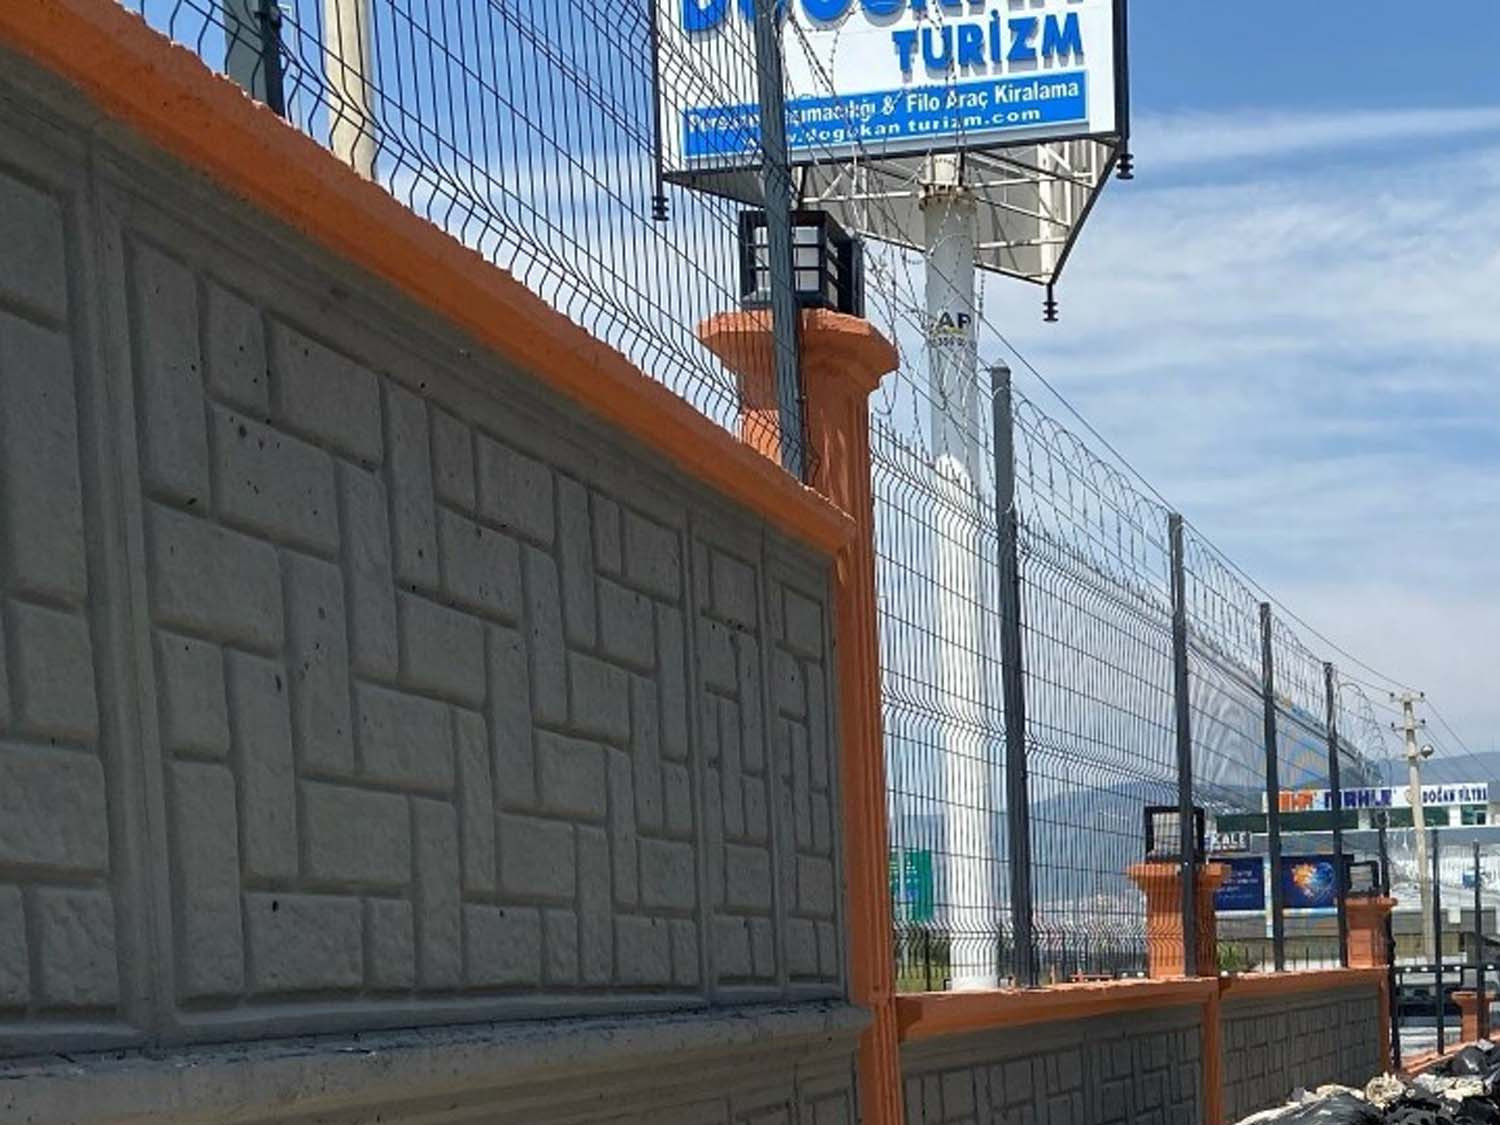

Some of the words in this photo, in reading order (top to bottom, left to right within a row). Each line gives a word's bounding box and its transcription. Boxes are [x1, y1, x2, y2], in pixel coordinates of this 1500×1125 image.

[891, 9, 1084, 77] TURİZM
[906, 90, 940, 113] Filo
[946, 89, 989, 110] Araç
[994, 79, 1079, 105] Kiralama
[907, 108, 1041, 133] turizm.com
